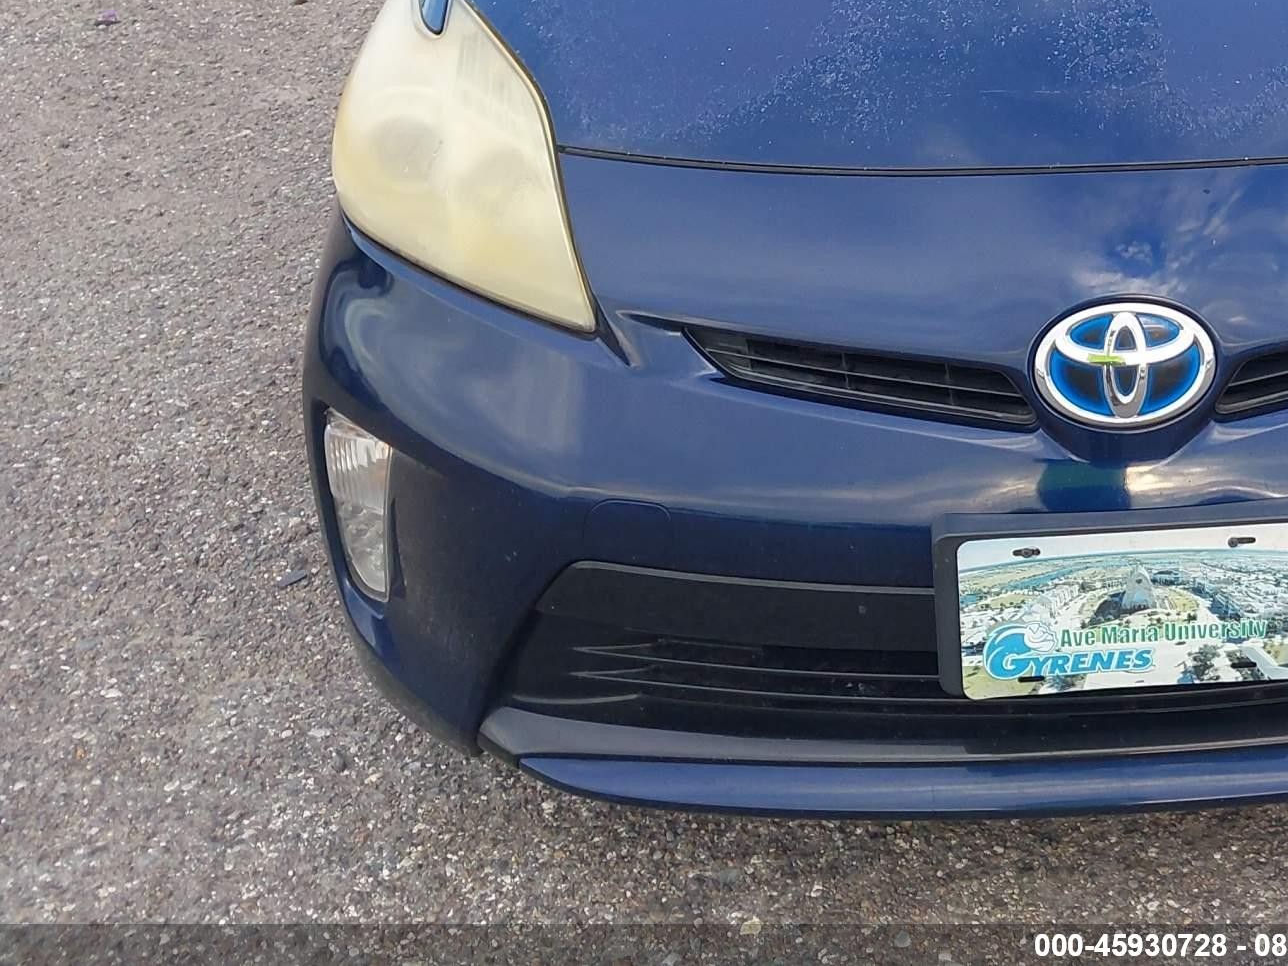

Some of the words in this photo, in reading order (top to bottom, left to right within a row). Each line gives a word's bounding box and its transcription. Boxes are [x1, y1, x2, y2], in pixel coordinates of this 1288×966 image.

[1060, 628, 1096, 647] Ave
[1101, 623, 1159, 645] Maria
[1164, 618, 1267, 642] University
[985, 642, 1154, 679] GYRENES
